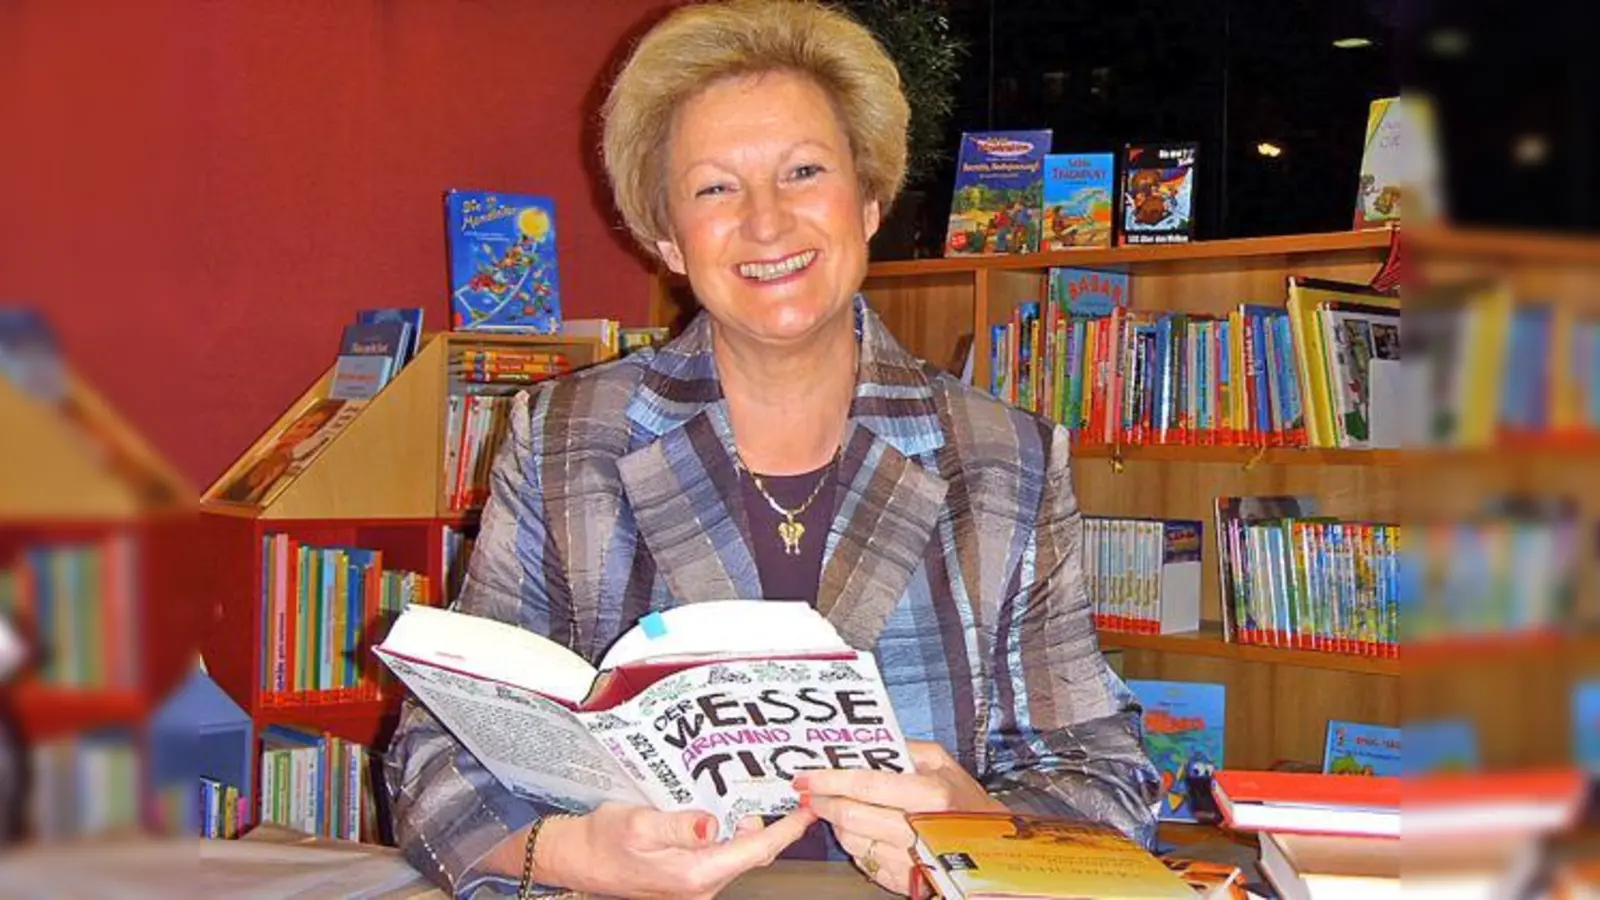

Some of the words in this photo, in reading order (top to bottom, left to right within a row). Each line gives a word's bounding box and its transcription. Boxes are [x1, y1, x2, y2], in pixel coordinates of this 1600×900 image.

[654, 700, 693, 732] DER
[681, 727, 791, 772] ARAVIND
[805, 727, 895, 743] ADIGA
[691, 746, 904, 797] TIGER
